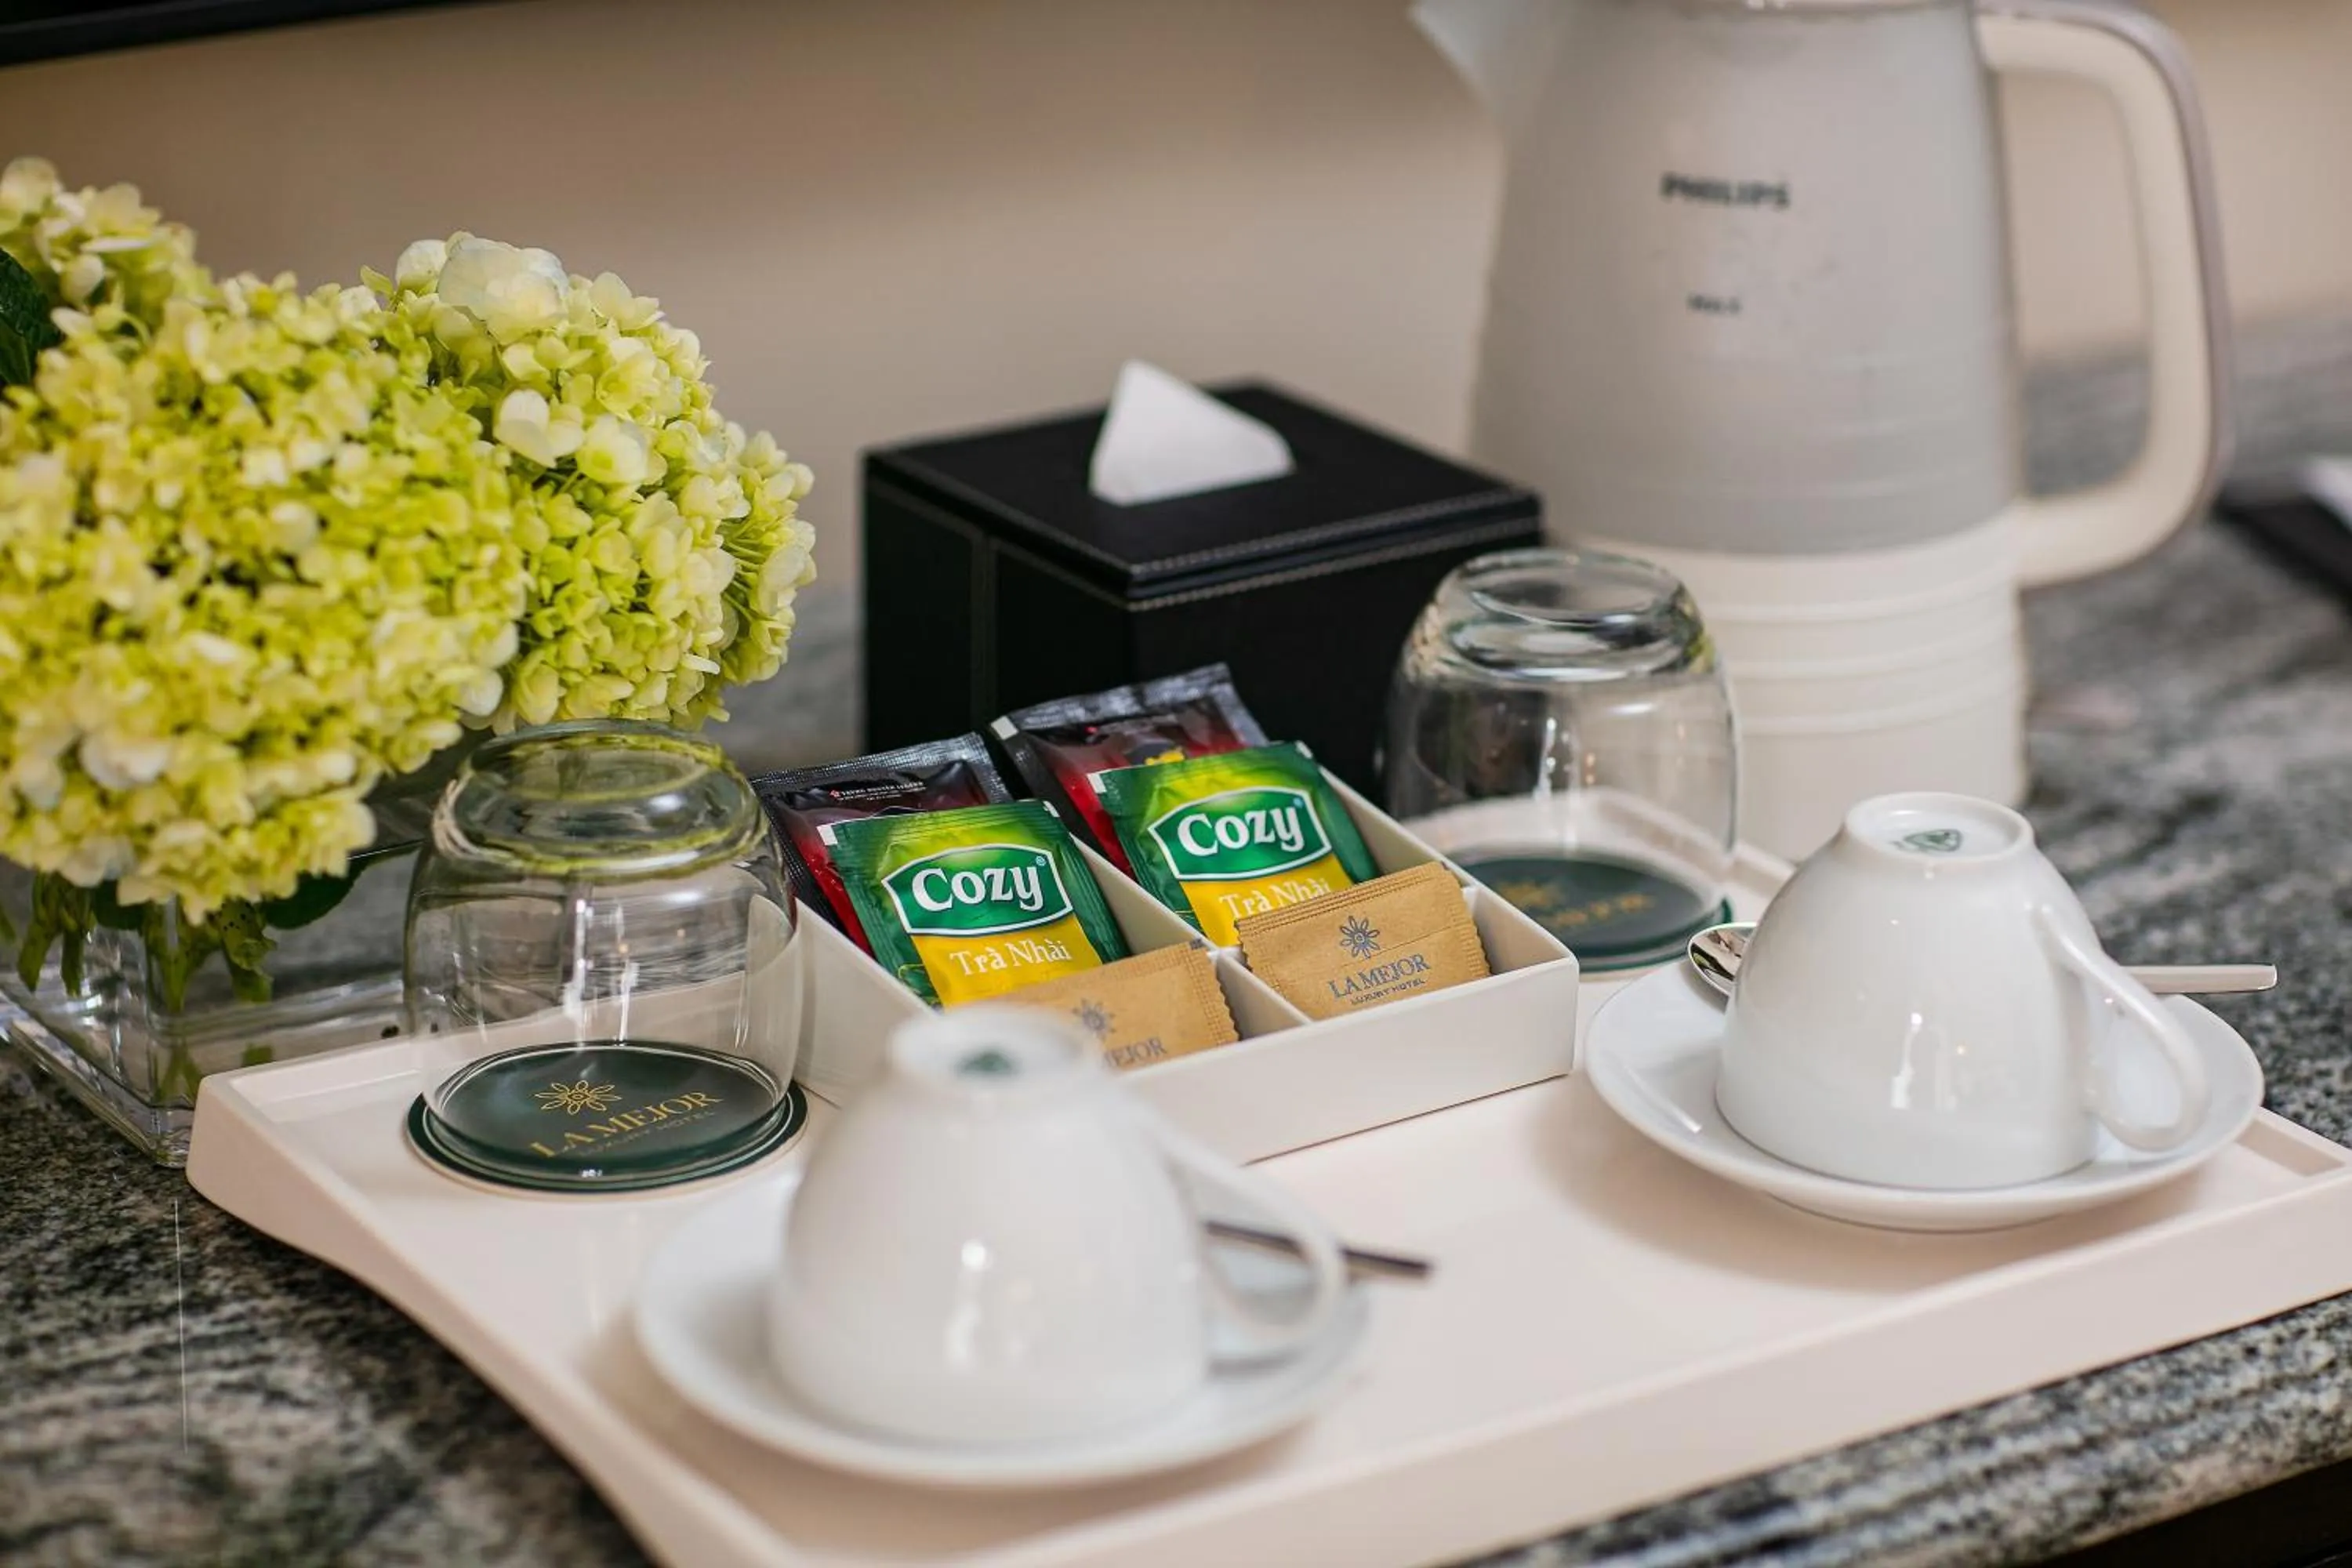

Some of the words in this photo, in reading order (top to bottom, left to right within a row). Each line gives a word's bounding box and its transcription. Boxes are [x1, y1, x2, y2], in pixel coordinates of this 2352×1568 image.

[1178, 806, 1305, 857] Cozy
[912, 866, 1044, 912] Cozy
[1218, 890, 1274, 919] Trà
[1269, 877, 1331, 908] Nhài
[949, 946, 1007, 976] Trà
[1005, 938, 1073, 967] Nhài
[1357, 953, 1432, 989] MEJOR
[1392, 978, 1426, 993] HOTEL
[586, 1091, 724, 1138] MEJOR
